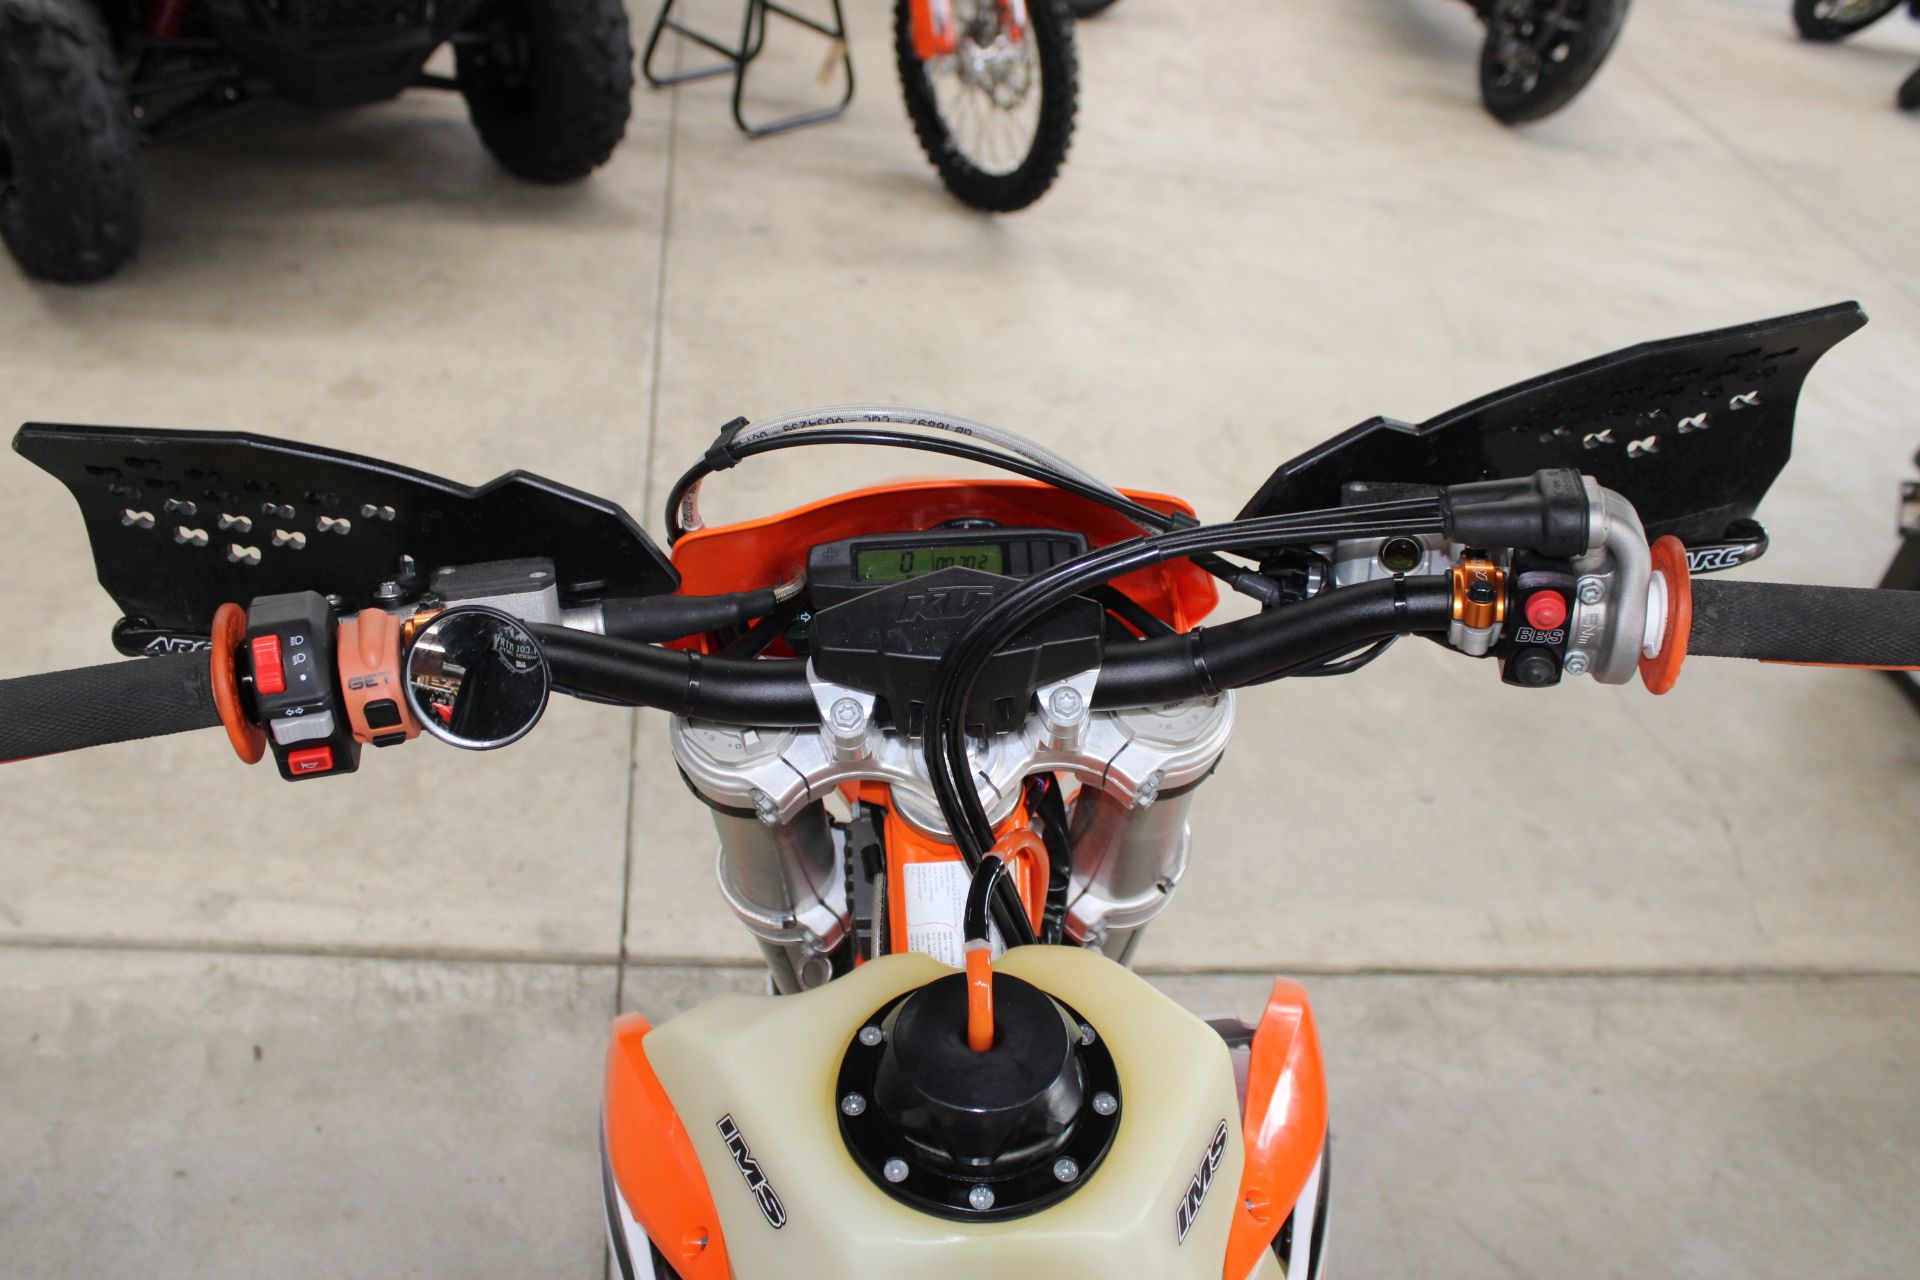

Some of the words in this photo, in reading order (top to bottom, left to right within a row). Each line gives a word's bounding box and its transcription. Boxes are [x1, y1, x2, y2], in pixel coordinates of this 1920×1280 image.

[894, 585, 995, 623] KT
[1515, 626, 1565, 645] BBS
[348, 671, 392, 691] GET
[715, 1112, 787, 1230] IMS
[1176, 1118, 1229, 1246] IMS
